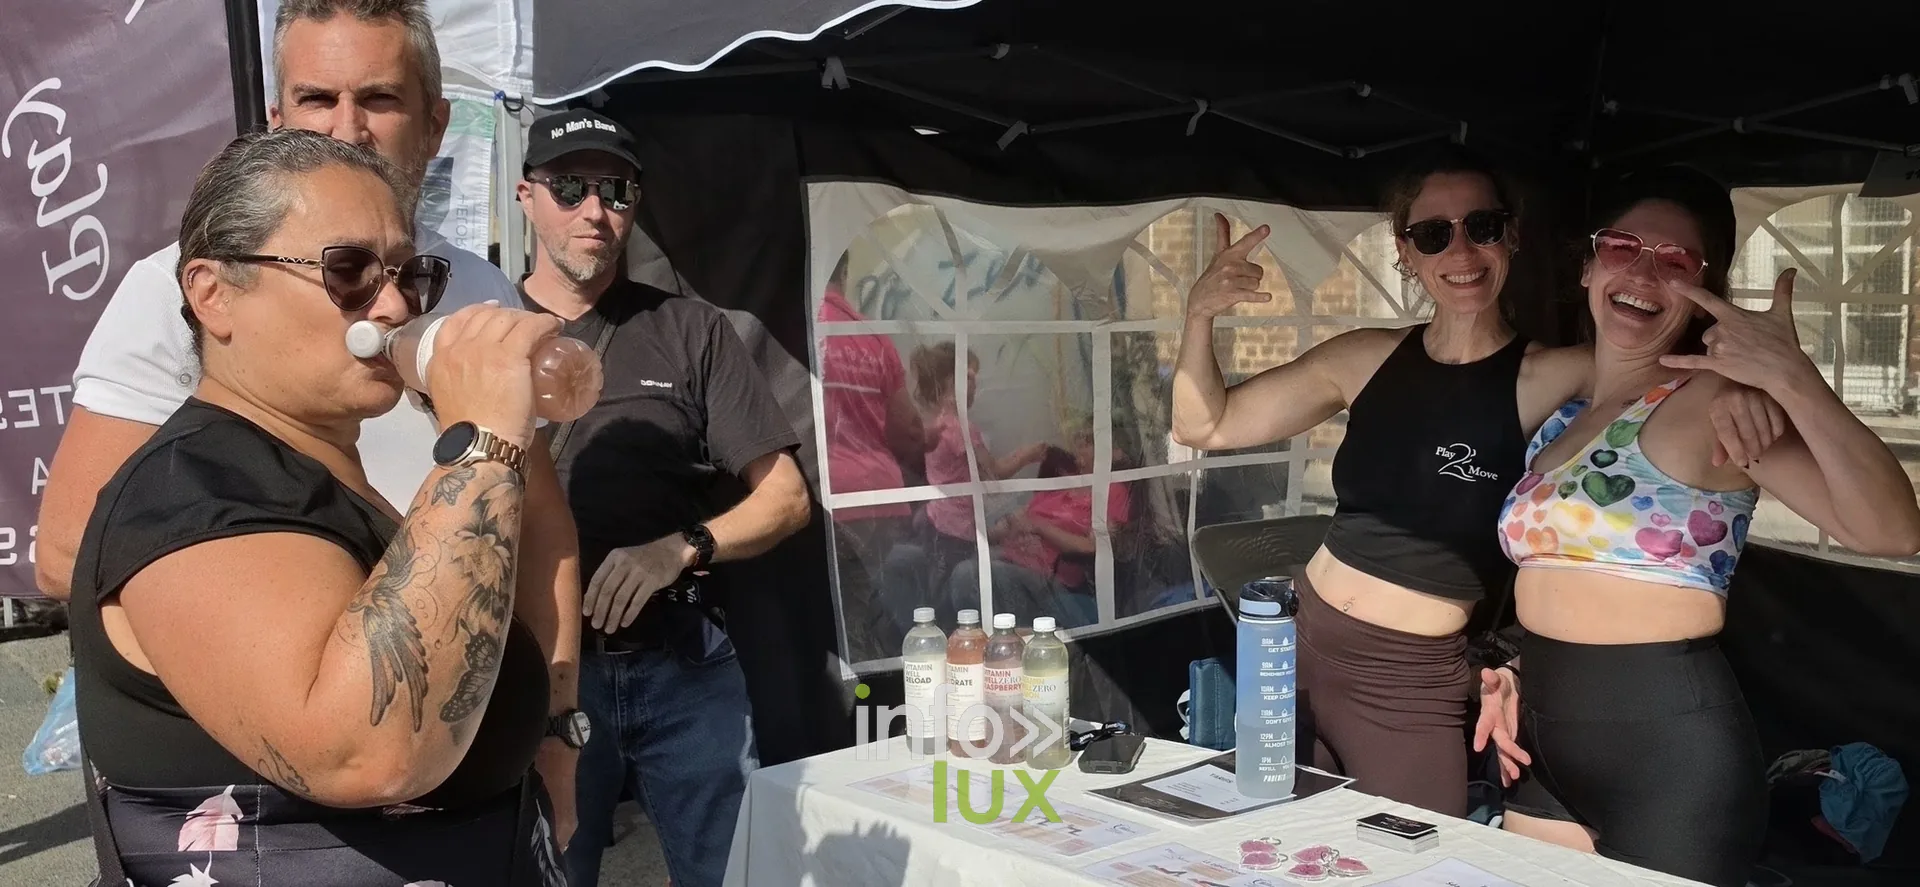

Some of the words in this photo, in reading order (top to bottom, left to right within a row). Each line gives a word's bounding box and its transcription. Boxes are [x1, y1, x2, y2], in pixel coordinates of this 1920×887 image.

[551, 128, 564, 139] No
[566, 118, 592, 133] Man's
[594, 120, 616, 133] Band
[1435, 446, 1456, 460] Play
[1467, 465, 1498, 480] Move
[1032, 685, 1057, 693] ZERO
